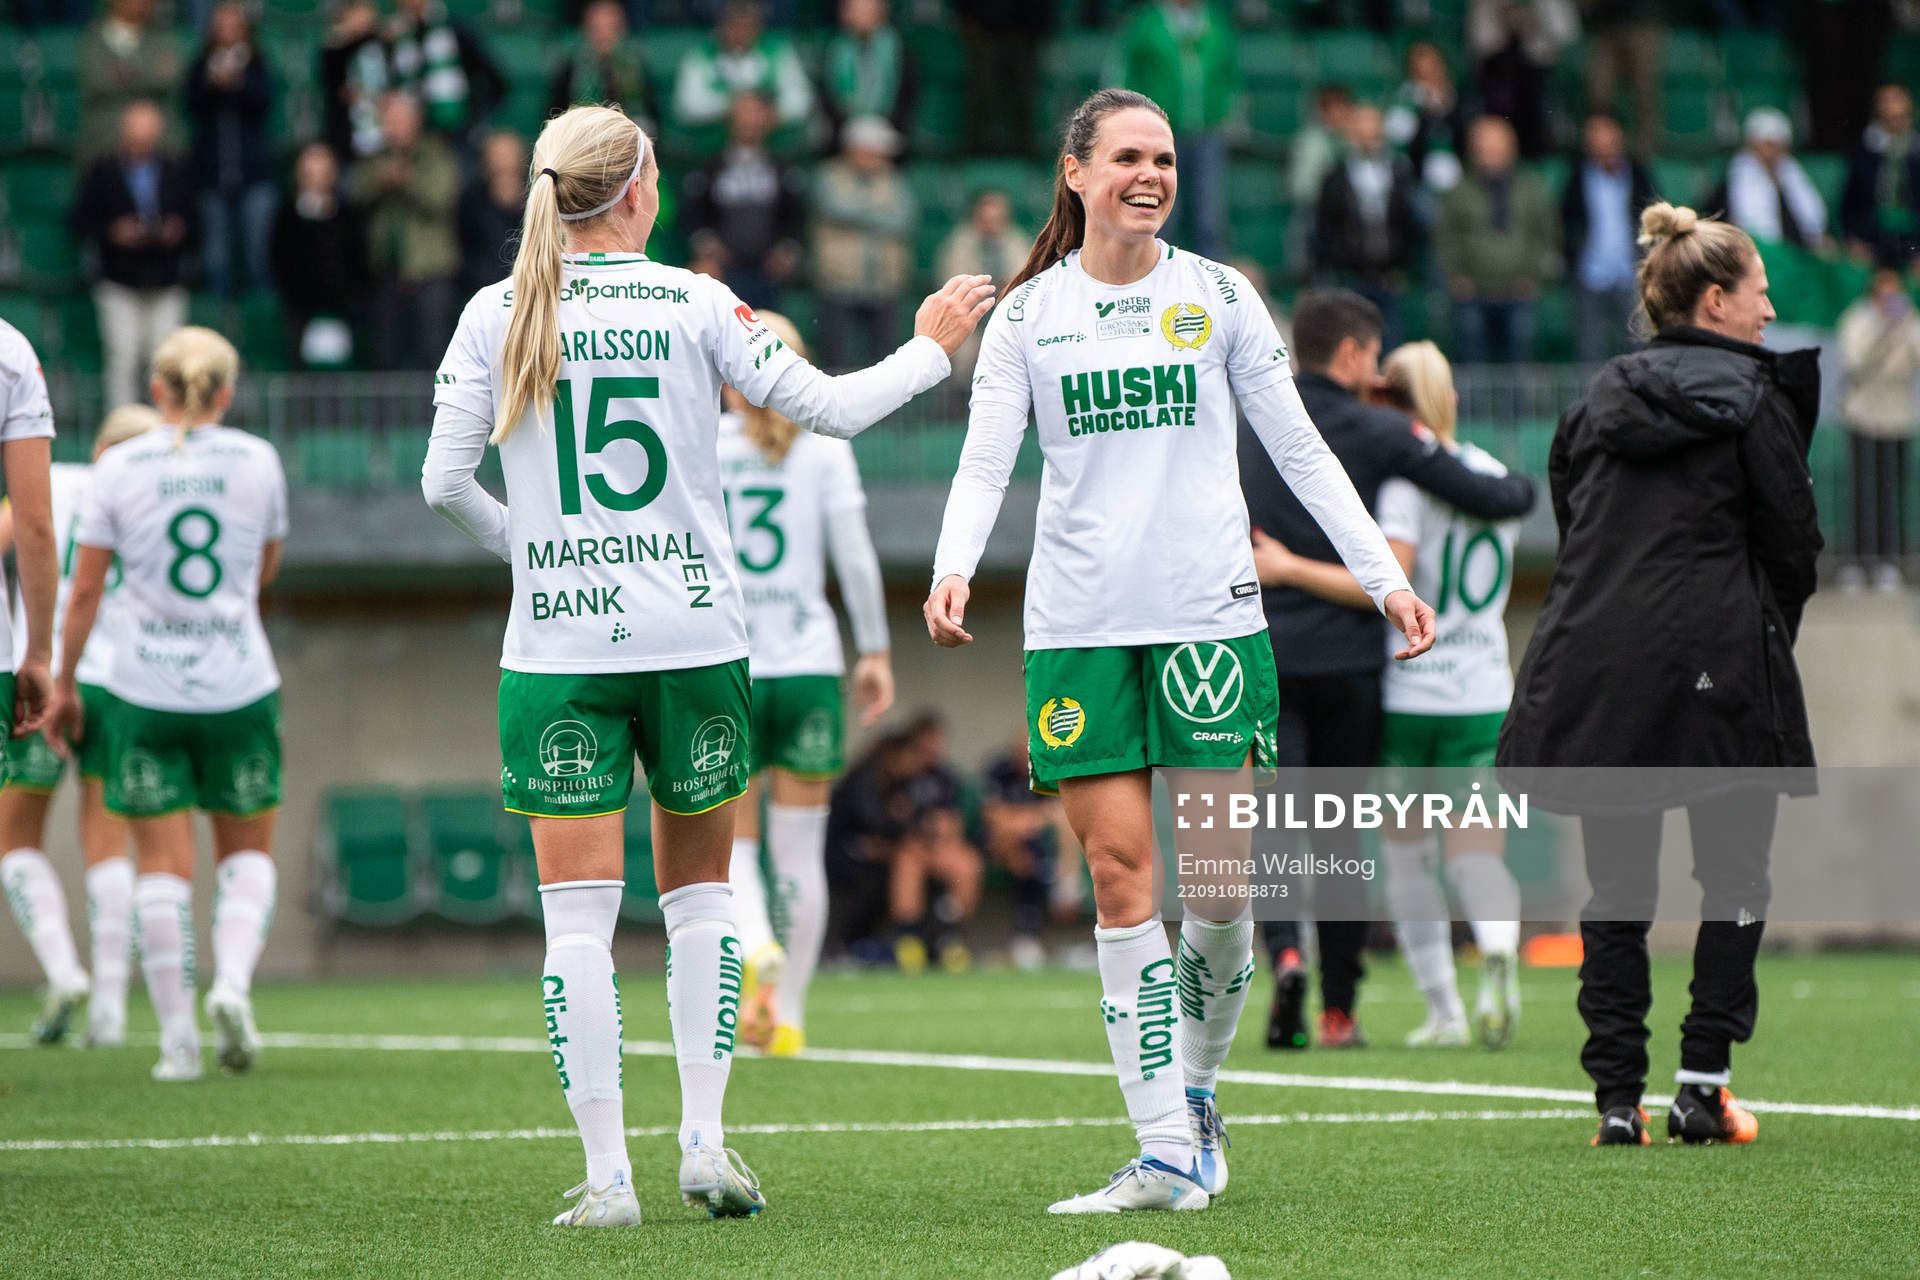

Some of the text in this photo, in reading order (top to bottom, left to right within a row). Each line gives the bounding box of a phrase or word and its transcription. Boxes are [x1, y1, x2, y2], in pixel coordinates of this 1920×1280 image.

[586, 281, 689, 304] pantbank
[1199, 258, 1238, 305] Convini
[1117, 296, 1151, 306] INTER
[1118, 304, 1151, 315] SPORT
[561, 329, 670, 362] ARLSSON
[1037, 334, 1076, 346] CRAFT
[1061, 364, 1197, 416] HUSKI
[1067, 406, 1196, 437] CHOCOLATE
[553, 376, 668, 516] 15
[168, 506, 223, 599] 8
[1437, 526, 1505, 615] 10
[532, 585, 625, 620] BANK
[1192, 731, 1235, 742] CRAFT
[527, 773, 614, 793] BOSPHORUS
[1137, 958, 1179, 1073] Clinton
